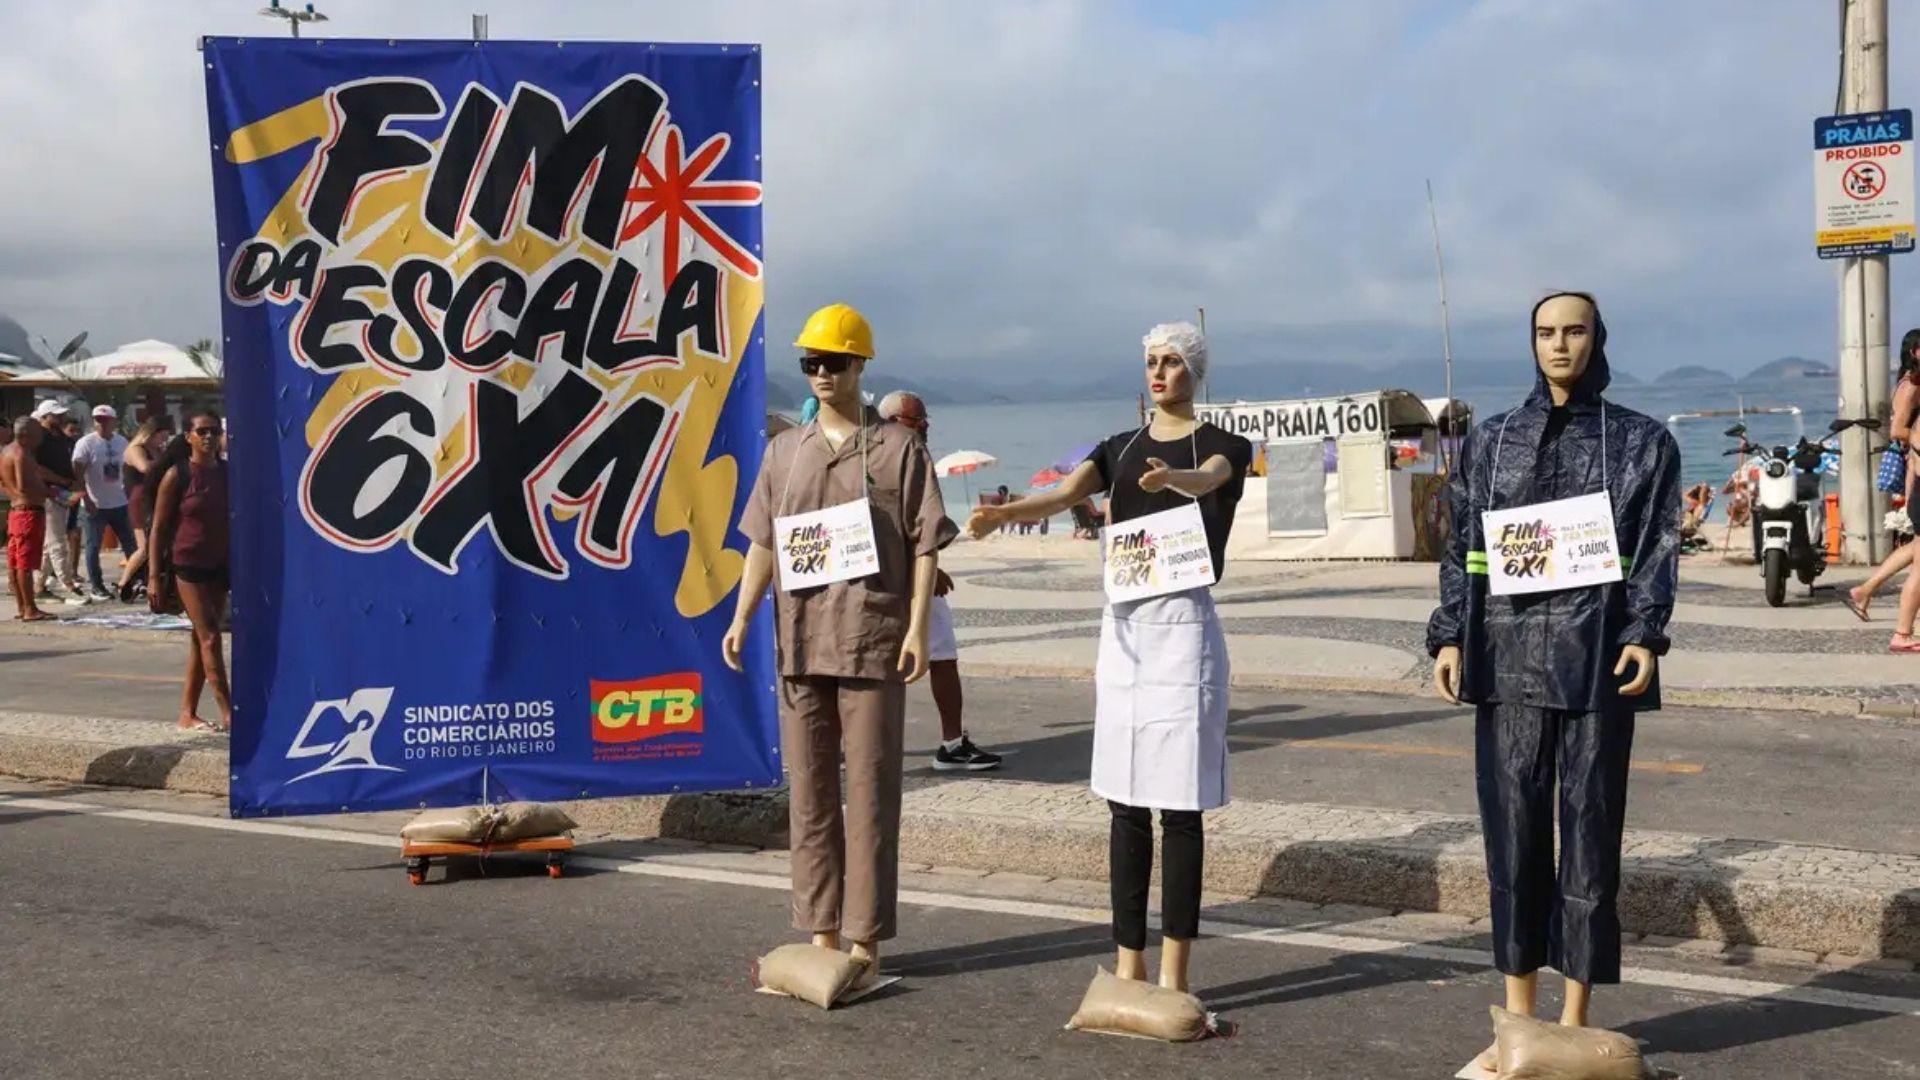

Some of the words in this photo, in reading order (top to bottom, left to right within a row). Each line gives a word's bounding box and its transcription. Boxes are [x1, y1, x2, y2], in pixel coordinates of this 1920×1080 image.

[1825, 122, 1901, 145] PRAIAS
[301, 75, 668, 249] FIM
[1826, 144, 1901, 161] PROIBIDO
[231, 240, 322, 301] DA
[295, 258, 730, 374] ESCALA
[1239, 414, 1261, 434] DA
[1263, 406, 1330, 437] PRAIA
[1333, 403, 1379, 434] 160
[303, 370, 679, 576] 6X1
[790, 523, 822, 544] FIM
[1112, 528, 1146, 553] FIM
[1501, 518, 1543, 542] FIM
[1501, 540, 1554, 557] ESCALA
[1578, 539, 1611, 557] SAÚDE
[792, 553, 826, 575] 6X1
[1113, 564, 1151, 587] 6X1
[1503, 555, 1547, 578] 6X1
[404, 702, 510, 724] SINDICATO
[514, 700, 555, 719] DOS
[598, 688, 696, 729] CTB
[403, 720, 556, 745] COMERCIÁRIOS
[404, 747, 426, 760] DO
[431, 746, 457, 758] RIO
[462, 744, 482, 757] DE
[487, 740, 556, 756] JANEIRO
